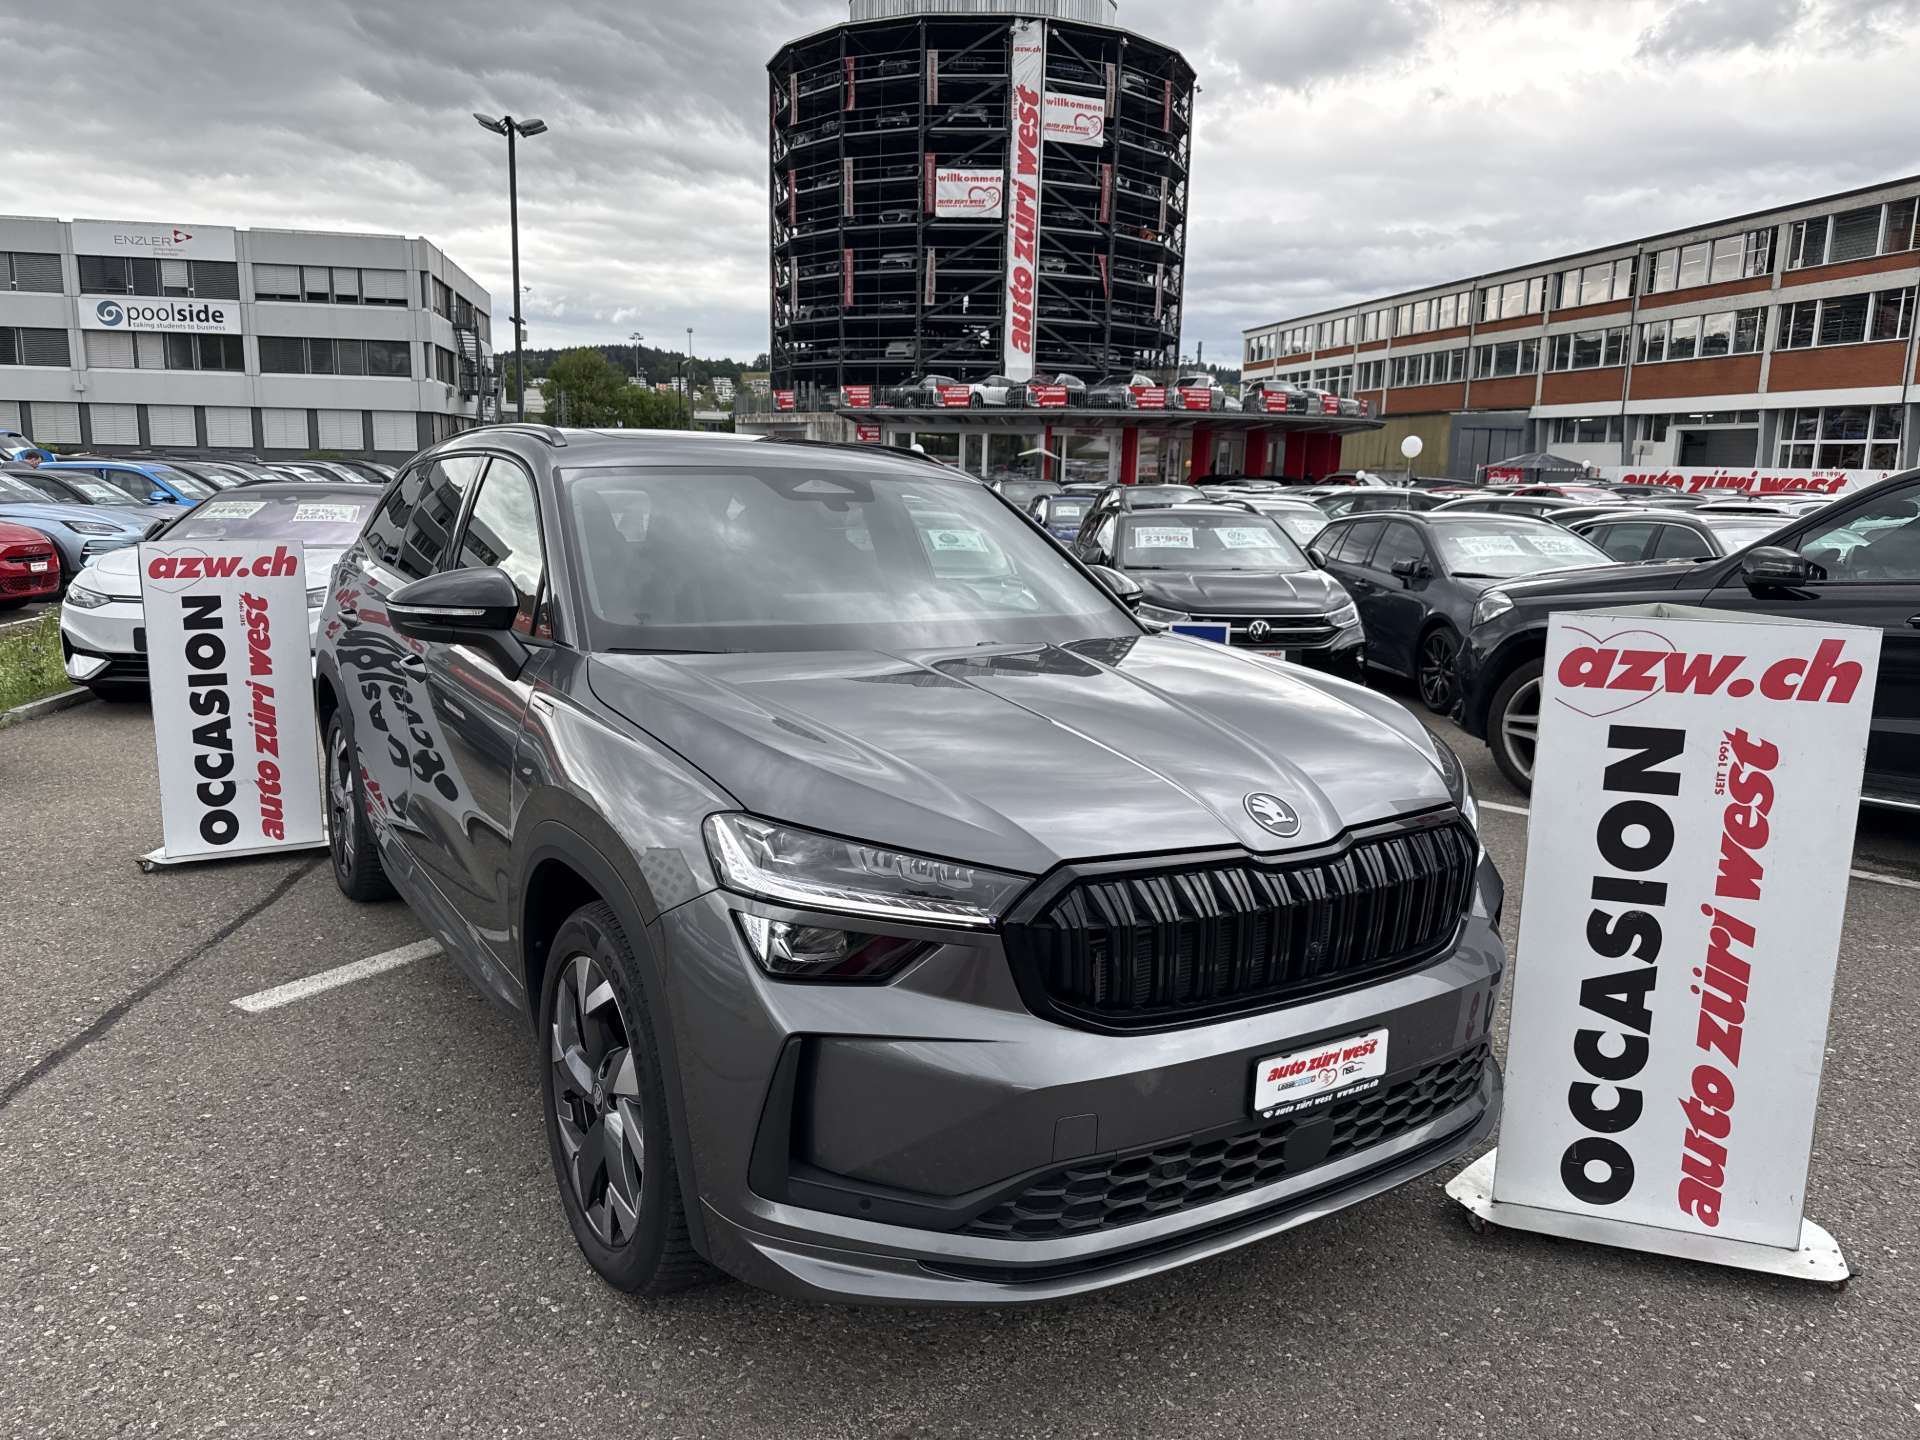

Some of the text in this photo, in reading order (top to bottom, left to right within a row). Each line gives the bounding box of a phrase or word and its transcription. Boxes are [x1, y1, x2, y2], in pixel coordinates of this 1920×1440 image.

[1046, 97, 1103, 112] willkommen
[938, 173, 1002, 183] willkommen
[114, 235, 172, 247] ENZLER
[1010, 84, 1039, 353] auto züri west
[127, 303, 225, 327] poolside
[149, 547, 298, 580] azw.ch
[1558, 639, 1863, 705] azw.ch
[182, 595, 240, 846] OCCASION
[240, 592, 285, 841] auto züri west
[1715, 741, 1730, 796] SEIT 1991
[1560, 724, 1687, 1206] OCCASION
[1678, 727, 1780, 1228] auto züri west
[1267, 1039, 1378, 1082] auto züri west
[1274, 1105, 1294, 1116] auto
[1314, 1094, 1333, 1104] west
